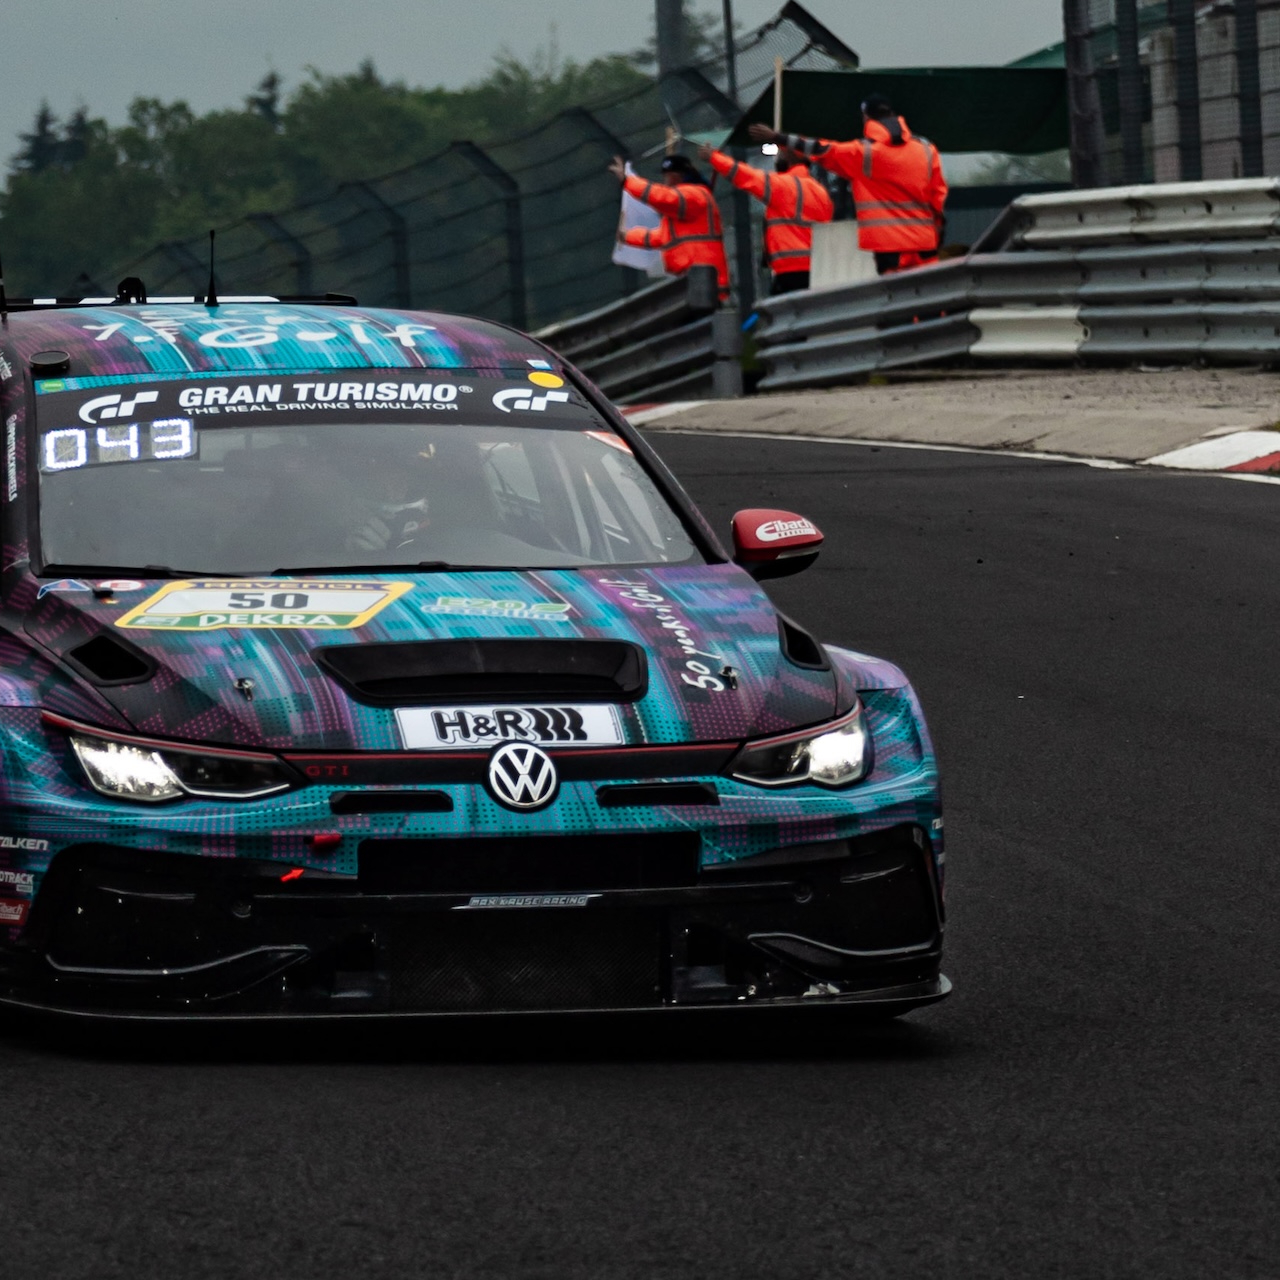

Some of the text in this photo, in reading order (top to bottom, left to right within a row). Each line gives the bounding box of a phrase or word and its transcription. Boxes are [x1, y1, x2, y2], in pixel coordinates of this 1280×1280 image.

[178, 383, 282, 408] GRAN
[183, 401, 459, 416] THE REAL DRIVING SIMULATOR
[44, 418, 192, 469] 043
[755, 517, 817, 542] Eibach
[204, 582, 375, 590] RAVENOL
[228, 592, 309, 610] 50
[199, 613, 337, 627] DEKRA
[431, 709, 533, 743] H&R
[304, 764, 350, 777] GTI
[470, 895, 497, 906] MAX
[541, 894, 587, 906] RACING
